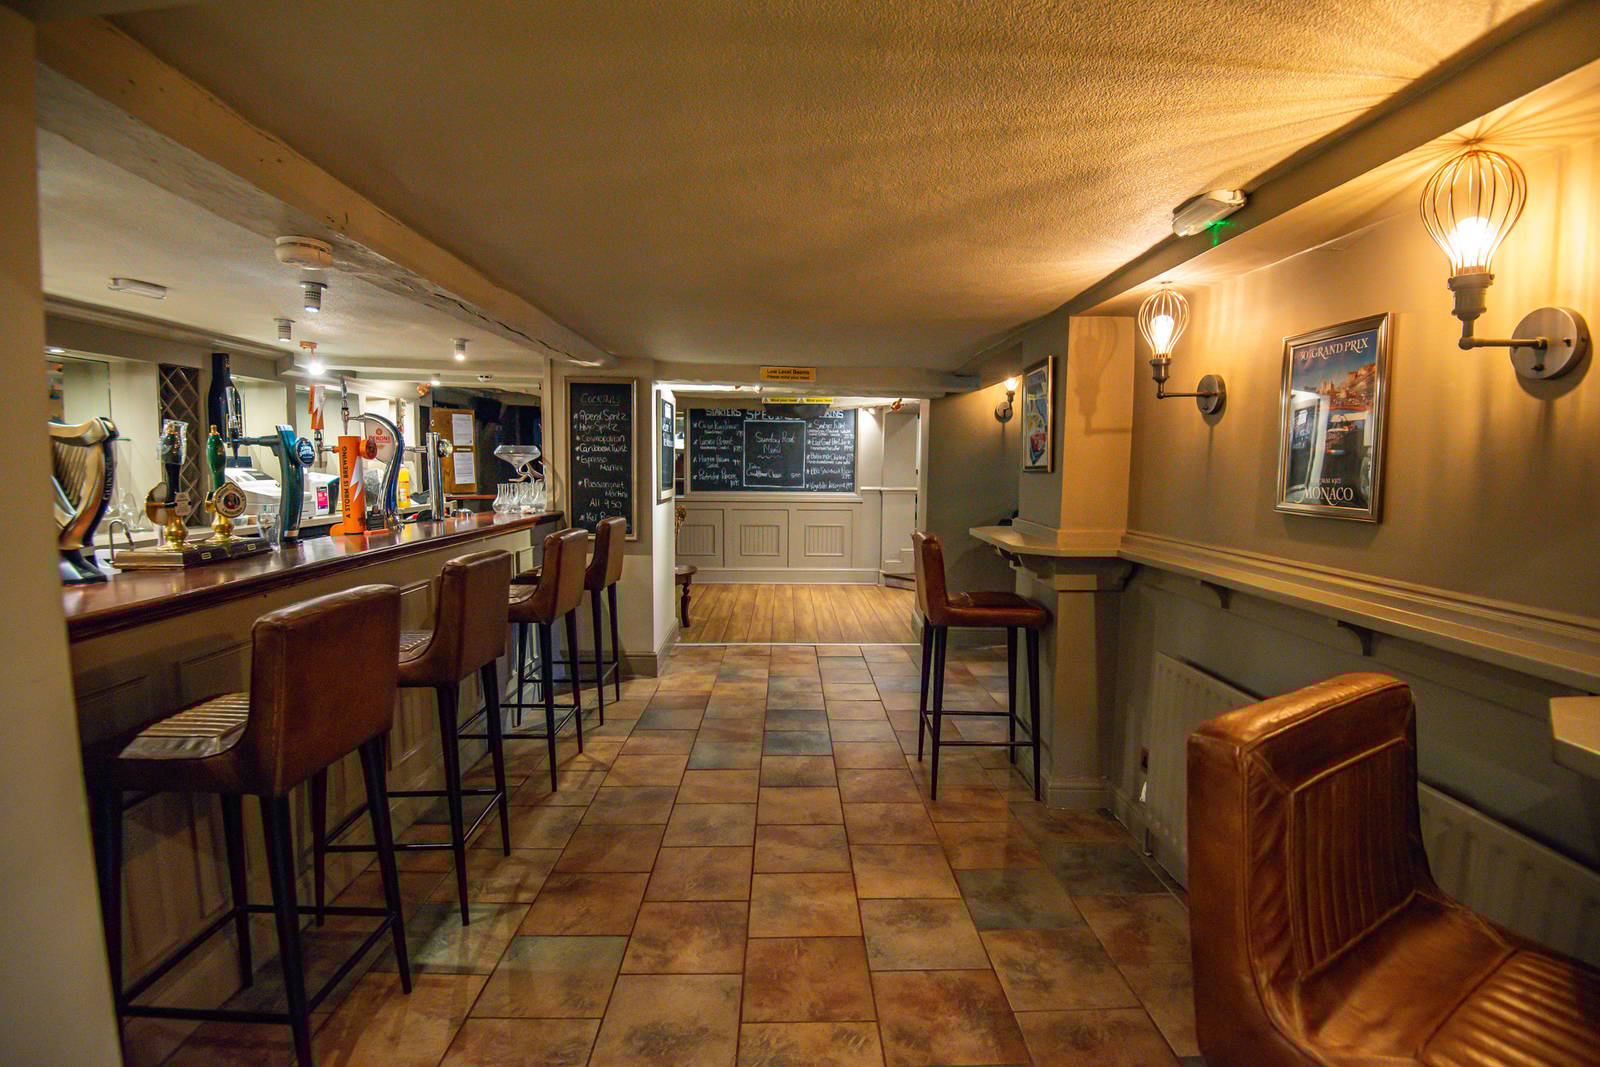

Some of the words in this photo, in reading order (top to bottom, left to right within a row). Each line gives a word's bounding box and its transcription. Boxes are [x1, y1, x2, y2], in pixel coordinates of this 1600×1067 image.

[1311, 343, 1343, 360] GRAND
[1344, 337, 1369, 354] PRIX
[1294, 486, 1353, 506] MONACO
